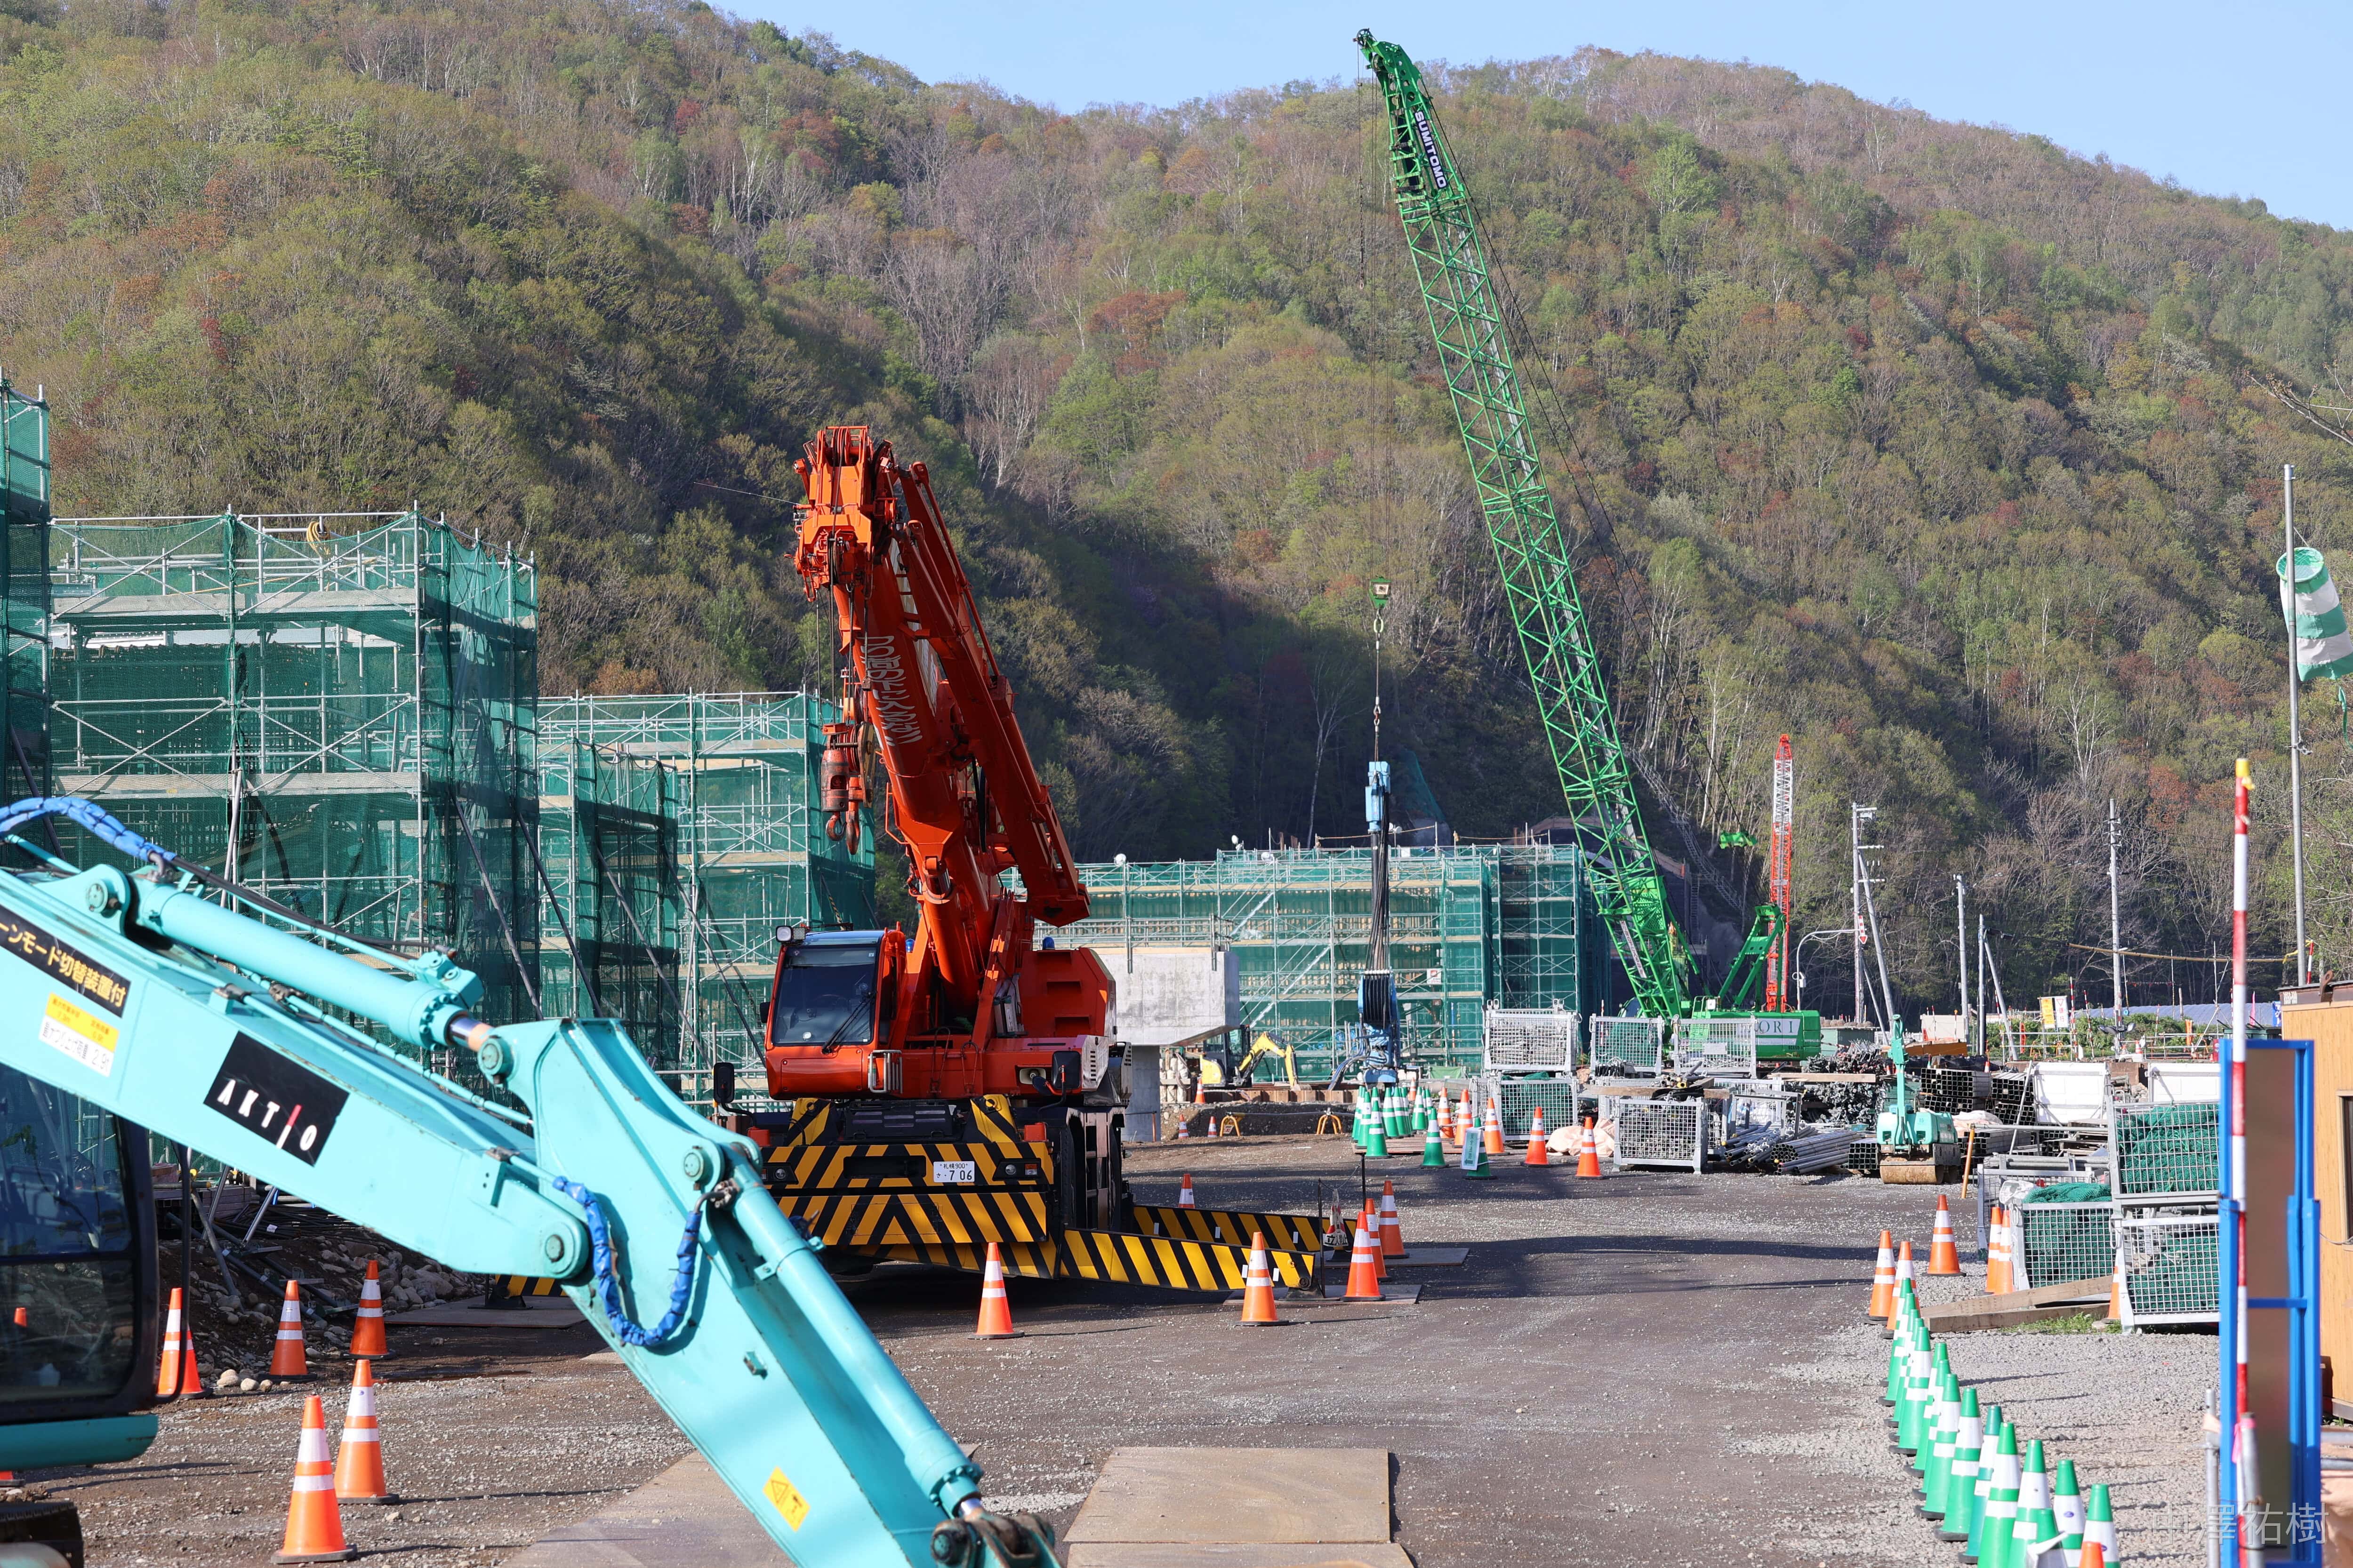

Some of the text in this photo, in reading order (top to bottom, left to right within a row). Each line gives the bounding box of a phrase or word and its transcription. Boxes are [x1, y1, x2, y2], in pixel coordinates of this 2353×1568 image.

[1414, 111, 1447, 189] SUMITOMO
[1743, 1020, 1793, 1033] ORI
[217, 1079, 318, 1152] AKTIO
